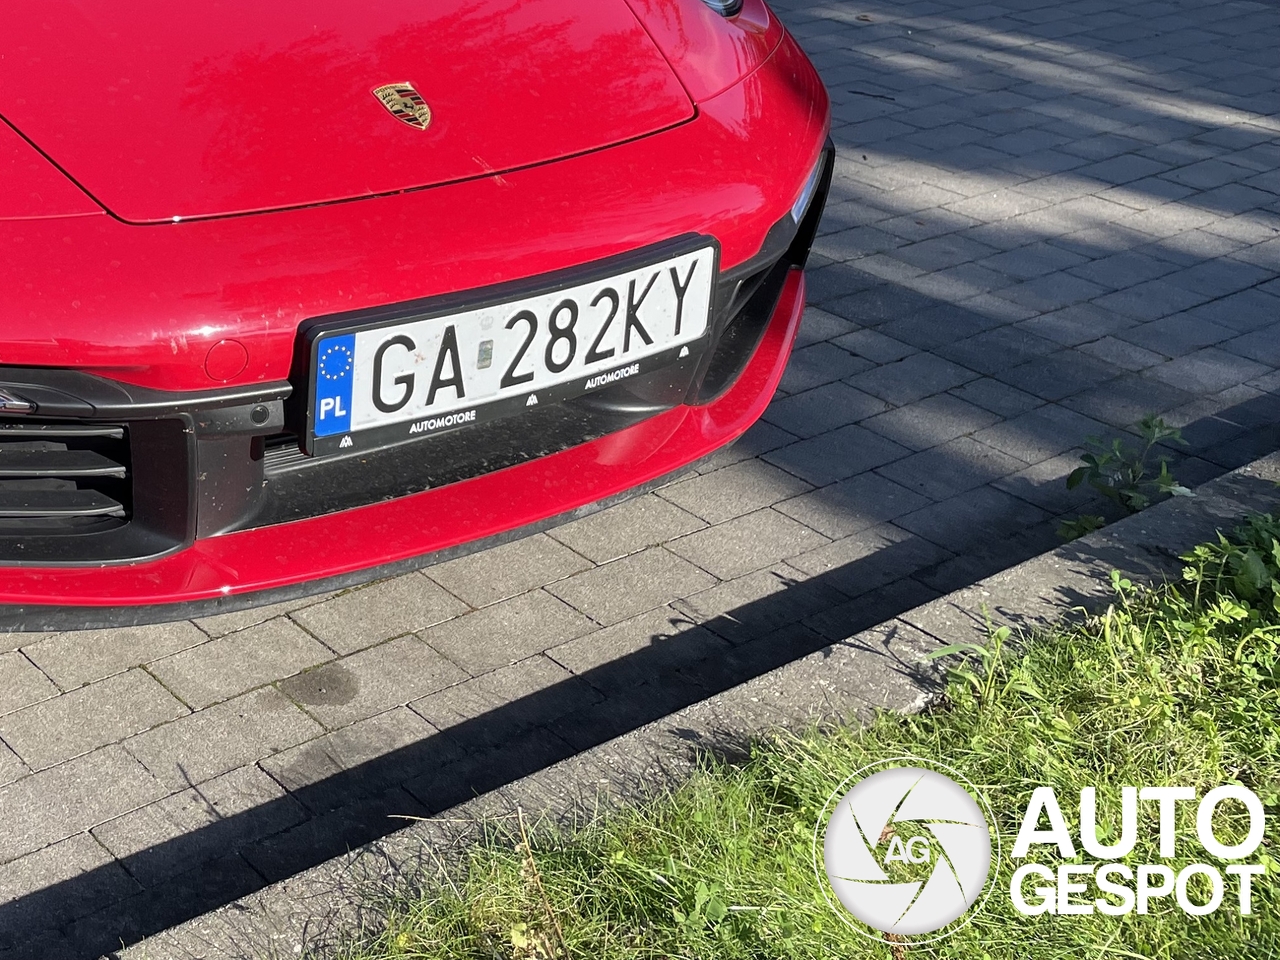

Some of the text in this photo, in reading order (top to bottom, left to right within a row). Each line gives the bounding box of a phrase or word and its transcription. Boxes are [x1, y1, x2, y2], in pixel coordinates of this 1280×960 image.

[372, 259, 699, 414] GA 282KY
[585, 364, 640, 389] AUTOMOTORE
[320, 396, 347, 420] PL
[409, 410, 476, 434] AUTOMOTORE
